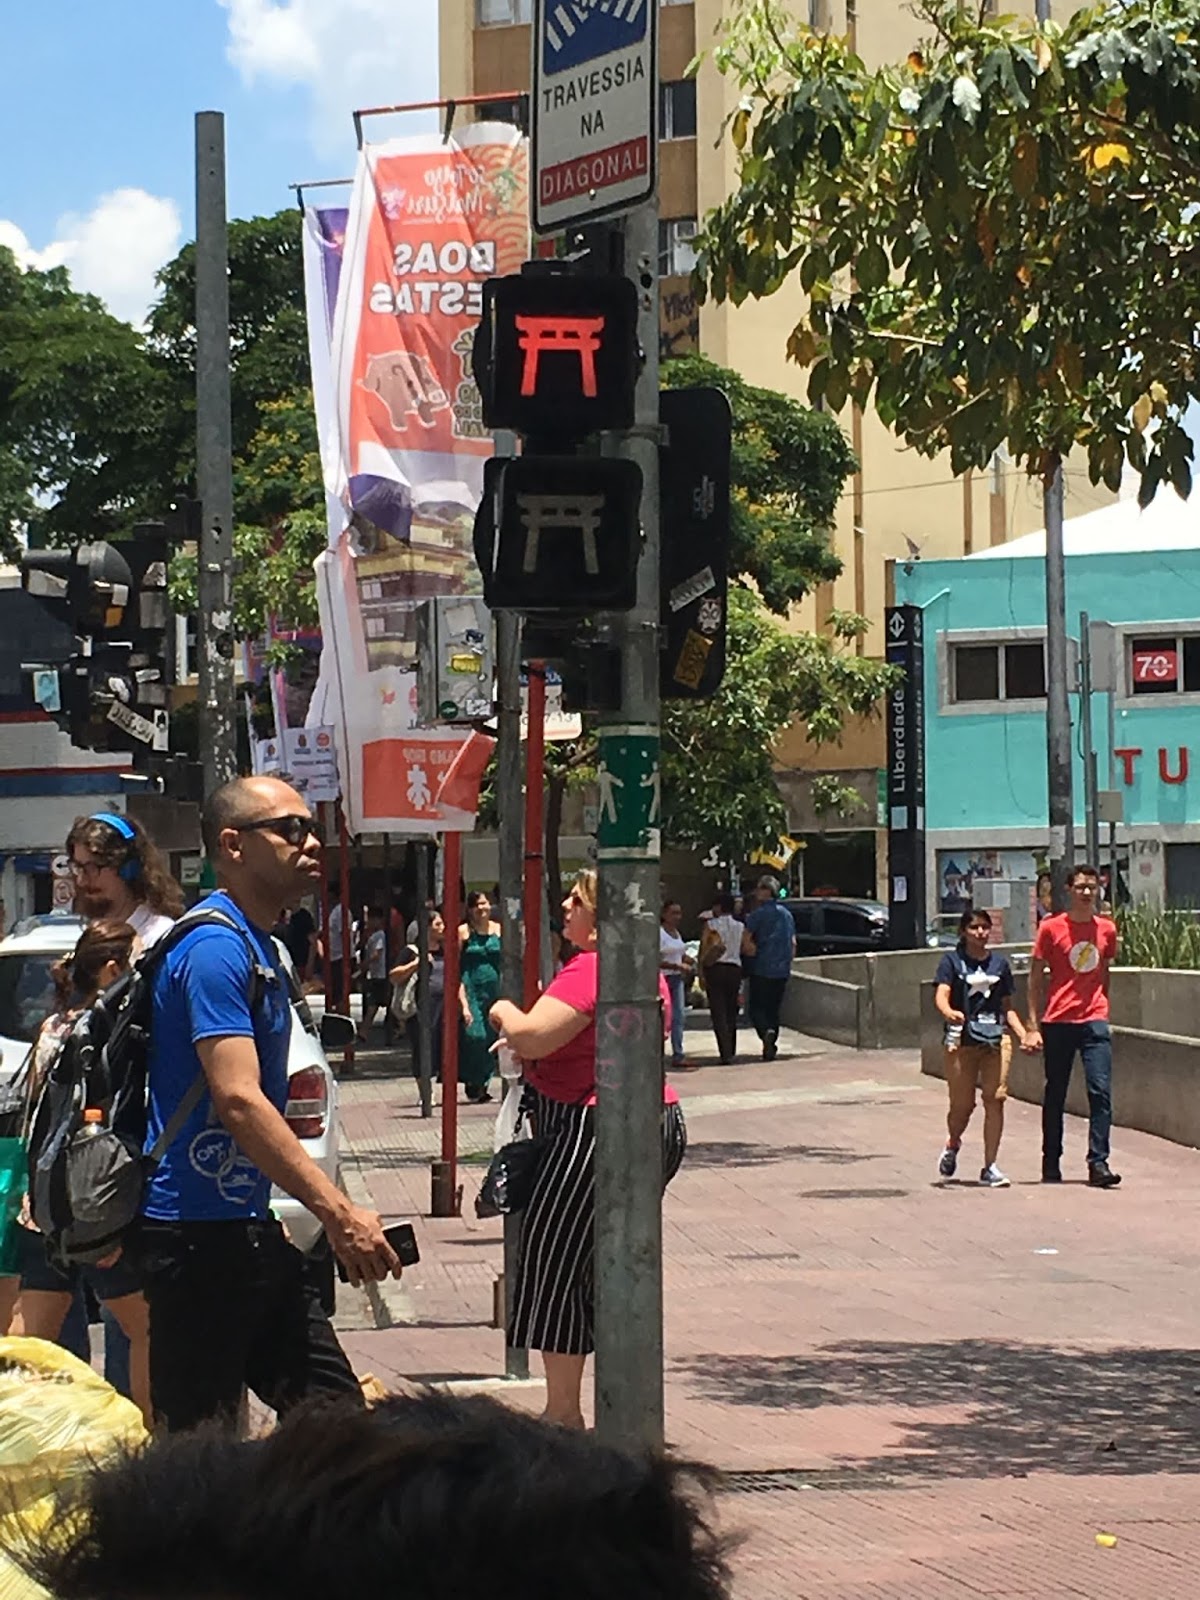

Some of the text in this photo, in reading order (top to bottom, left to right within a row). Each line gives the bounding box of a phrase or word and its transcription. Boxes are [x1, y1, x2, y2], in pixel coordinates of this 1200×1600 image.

[542, 55, 645, 112] TRAVESSIA
[580, 109, 605, 138] NA
[541, 146, 645, 199] DIAGONAL
[893, 689, 905, 793] Liberdade
